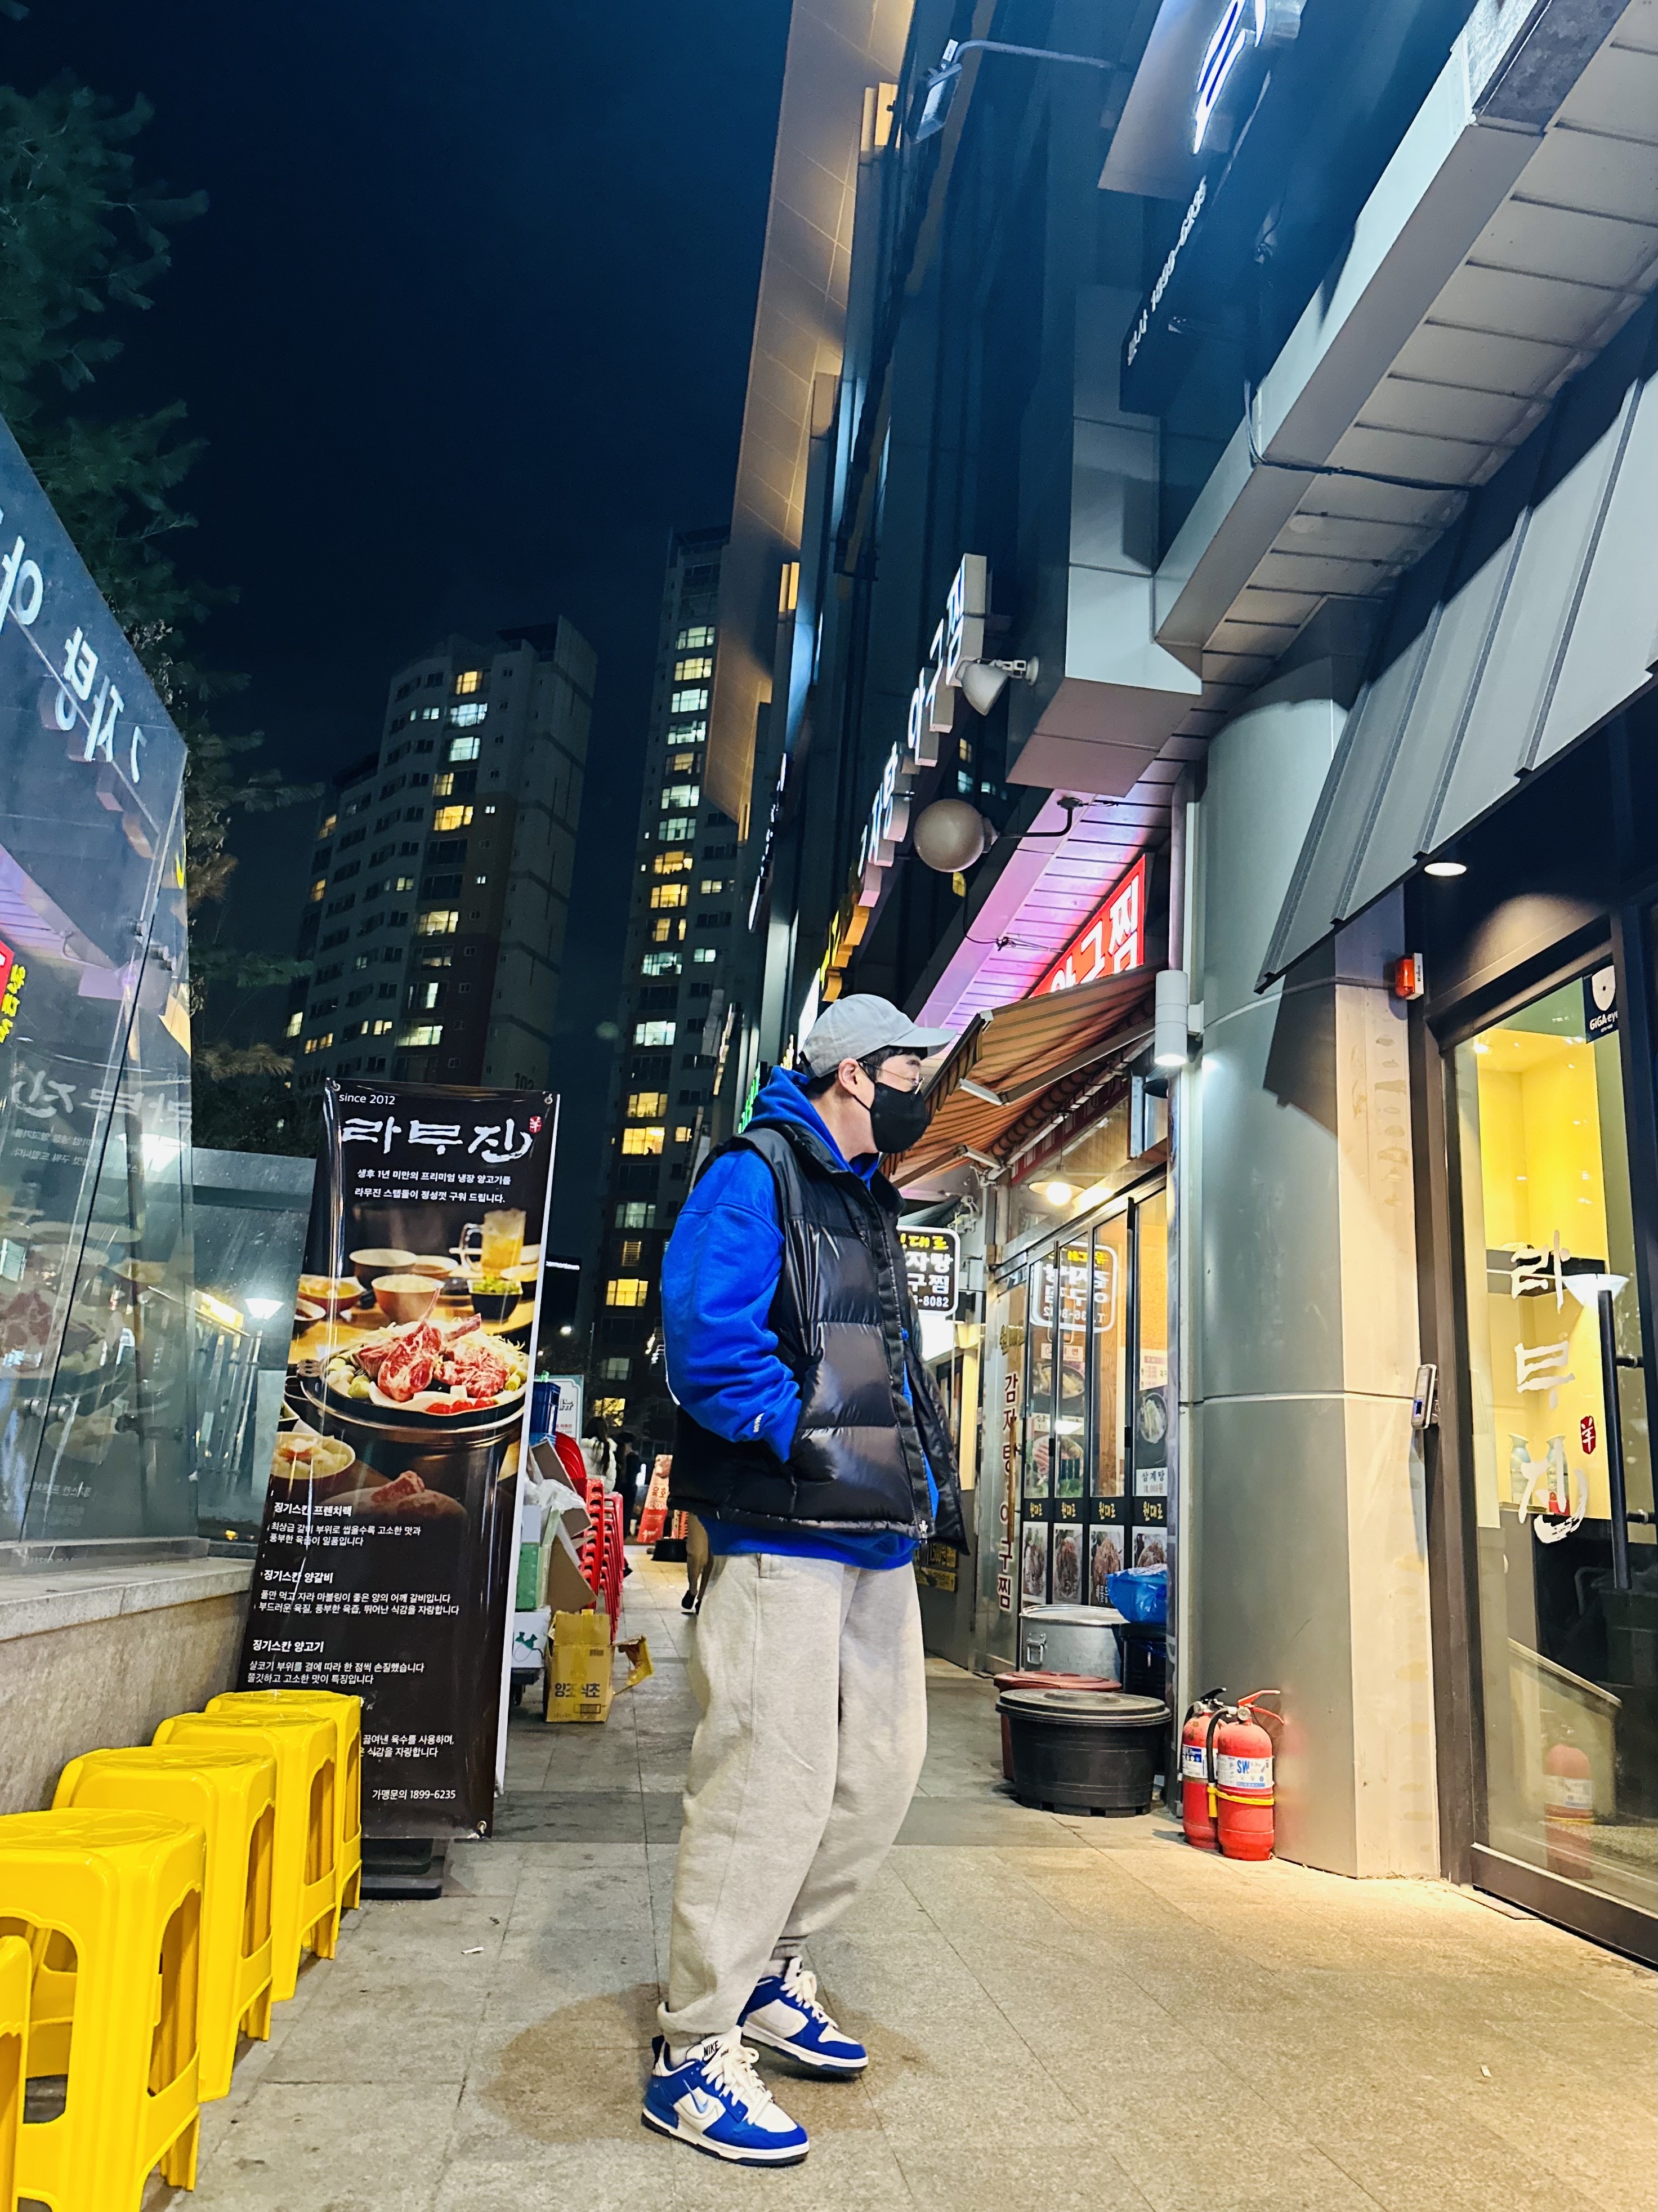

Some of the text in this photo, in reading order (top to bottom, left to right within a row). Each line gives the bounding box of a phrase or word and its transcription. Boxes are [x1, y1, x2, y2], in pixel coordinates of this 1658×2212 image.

[339, 1094, 396, 1105] since 2012
[341, 1116, 533, 1164] 라무진
[357, 1169, 511, 1185] 생후 1년 미만의 프리미엄 냉장 양고기를
[354, 1187, 382, 1198] 라무진
[421, 1190, 447, 1201] 정성껏
[449, 1192, 467, 1202] 구워
[468, 1193, 506, 1204] 드립니다.
[905, 1251, 954, 1274] 자탕
[907, 1273, 950, 1295] 구찜
[1141, 1470, 1165, 1482] 삼계탕
[1061, 1501, 1076, 1519] 원대로
[1098, 1501, 1116, 1520] 원대로
[1142, 1500, 1164, 1522] 원대로
[271, 1522, 295, 1533] 최상급
[315, 1525, 340, 1535] 부위로
[342, 1525, 376, 1535] 씹을수록
[377, 1526, 403, 1536] 고소한
[404, 1526, 421, 1536] 맛과
[269, 1533, 293, 1544] 풍부한
[322, 1536, 364, 1546] 일품입니다
[263, 1569, 333, 1584] 징기스칸 양갈비
[261, 1589, 452, 1604] 풀만 먹고 자라 마블링이 좋은 양의 어깨 갈비입니다
[258, 1601, 459, 1616] 부드러운 육질, 풍부한 육즙, 뛰어난 식감을 자랑합니다
[252, 1639, 324, 1653] 징기스칸 양고기
[249, 1660, 425, 1674] 살코기 부위를 결에 따라 한 점씩 손질했습니다
[283, 1674, 309, 1684] 고소한
[311, 1674, 329, 1685] 맛이
[331, 1674, 374, 1685] 특징입니다
[363, 1734, 455, 1745] 끓여낸 육수를 사용하며,
[367, 1747, 394, 1758] 식감을
[395, 1747, 439, 1758] 자랑합니다
[372, 1789, 456, 1800] 가맹문의 1899-6235
[703, 2040, 719, 2058] NIKE
